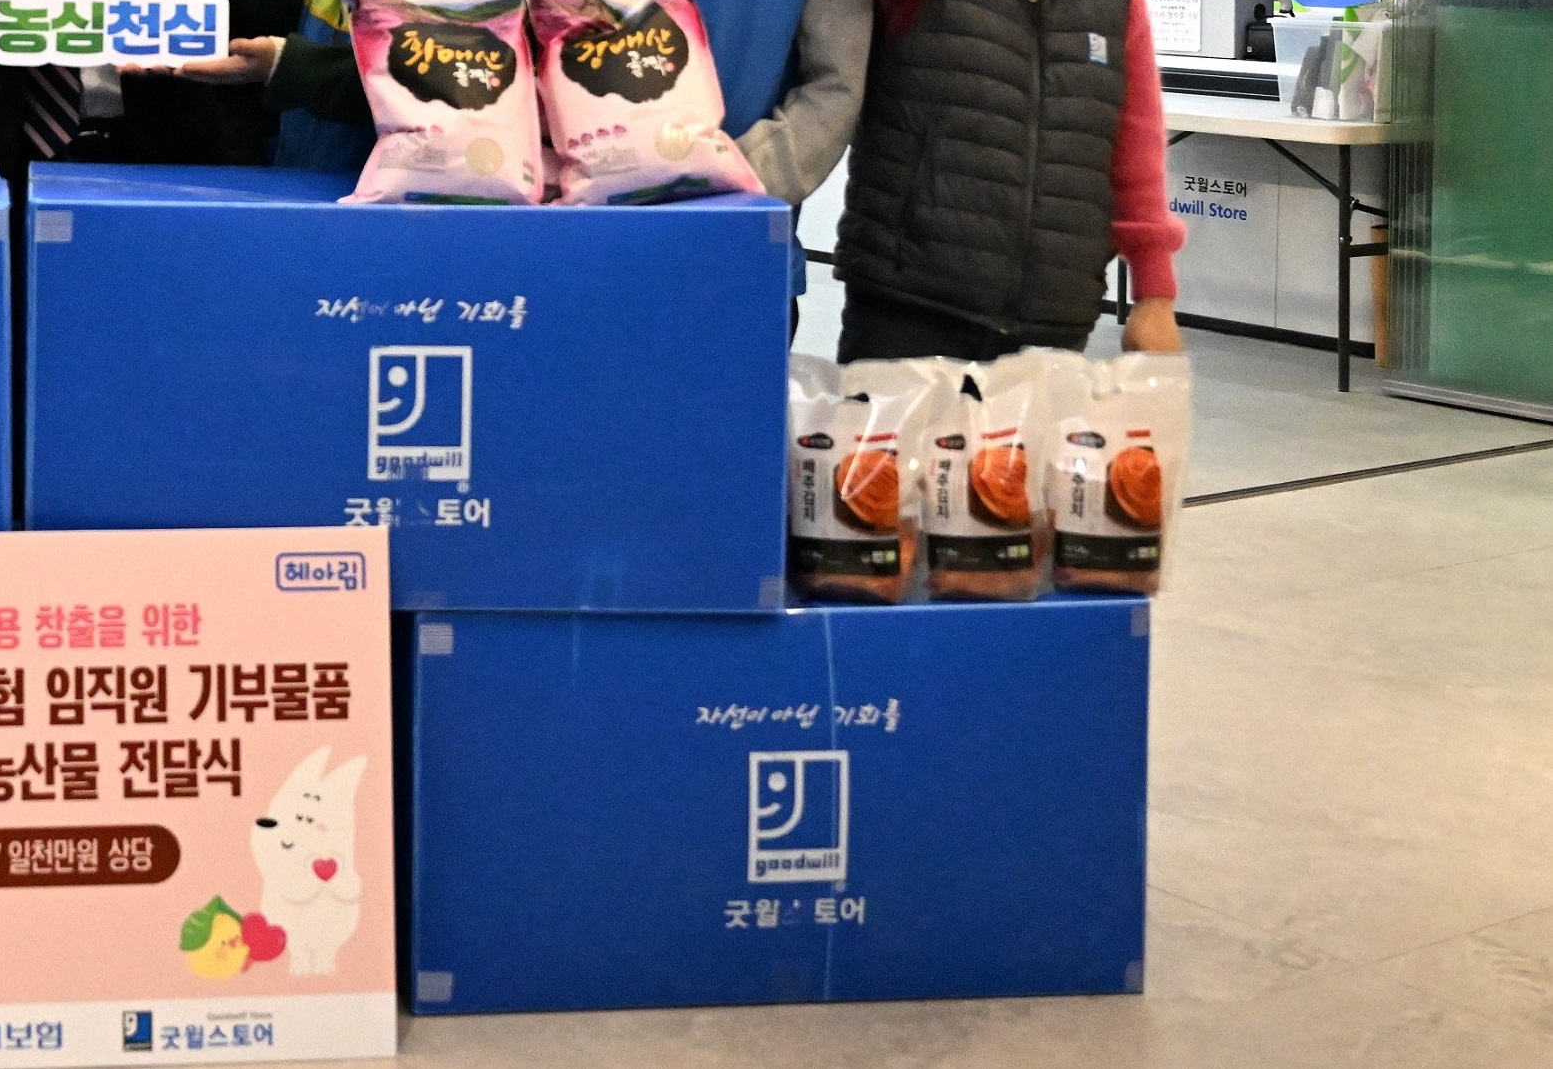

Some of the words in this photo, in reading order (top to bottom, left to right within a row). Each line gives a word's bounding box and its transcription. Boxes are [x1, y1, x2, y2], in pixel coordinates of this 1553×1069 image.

[1184, 175, 1247, 197] 굿윌스토어
[1169, 198, 1204, 216] dwill
[1209, 202, 1247, 221] Store
[315, 296, 389, 323] 자선이
[394, 297, 444, 323] 아닌
[456, 294, 528, 329] 기회를
[375, 451, 462, 474] goodwill
[344, 497, 491, 529] 굿윌토어
[283, 561, 359, 591] 헤아림
[35, 604, 127, 649] 창출을
[143, 602, 202, 647] 위한
[46, 664, 168, 727] 임직원
[189, 661, 352, 724] 기부물품
[695, 702, 768, 731] 자선이
[771, 703, 821, 729] 아닌
[832, 698, 901, 732] 기회를
[118, 738, 243, 800] 전달식
[7, 839, 100, 876] 일천만원
[108, 837, 154, 874] 상당
[755, 852, 840, 878] goodwill
[724, 895, 867, 929] 굿윌토어
[159, 1022, 274, 1050] 굿윌스토어
